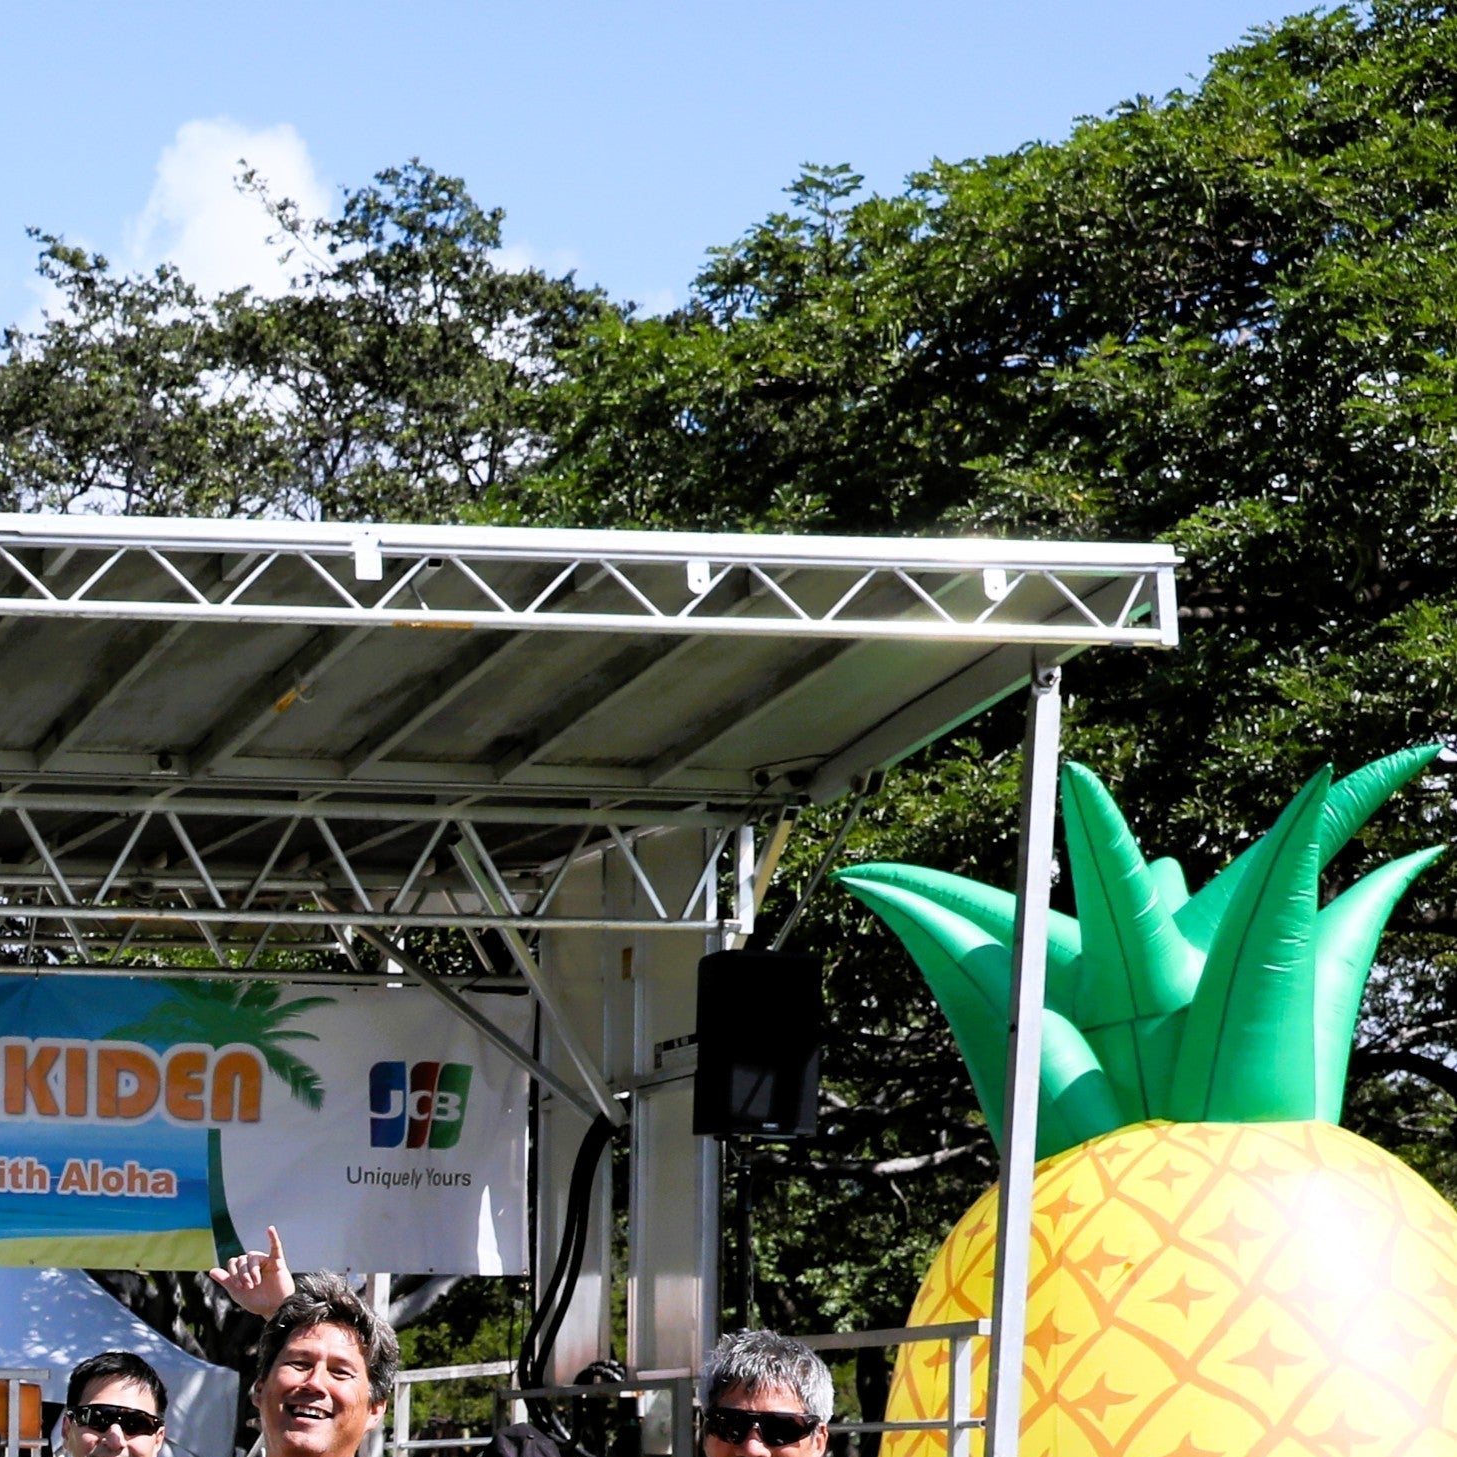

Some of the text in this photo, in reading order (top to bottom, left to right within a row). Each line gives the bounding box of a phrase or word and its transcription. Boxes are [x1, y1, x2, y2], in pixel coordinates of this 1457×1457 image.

[60, 1162, 175, 1195] Aloha
[347, 1166, 472, 1190] Uniquely Yours
